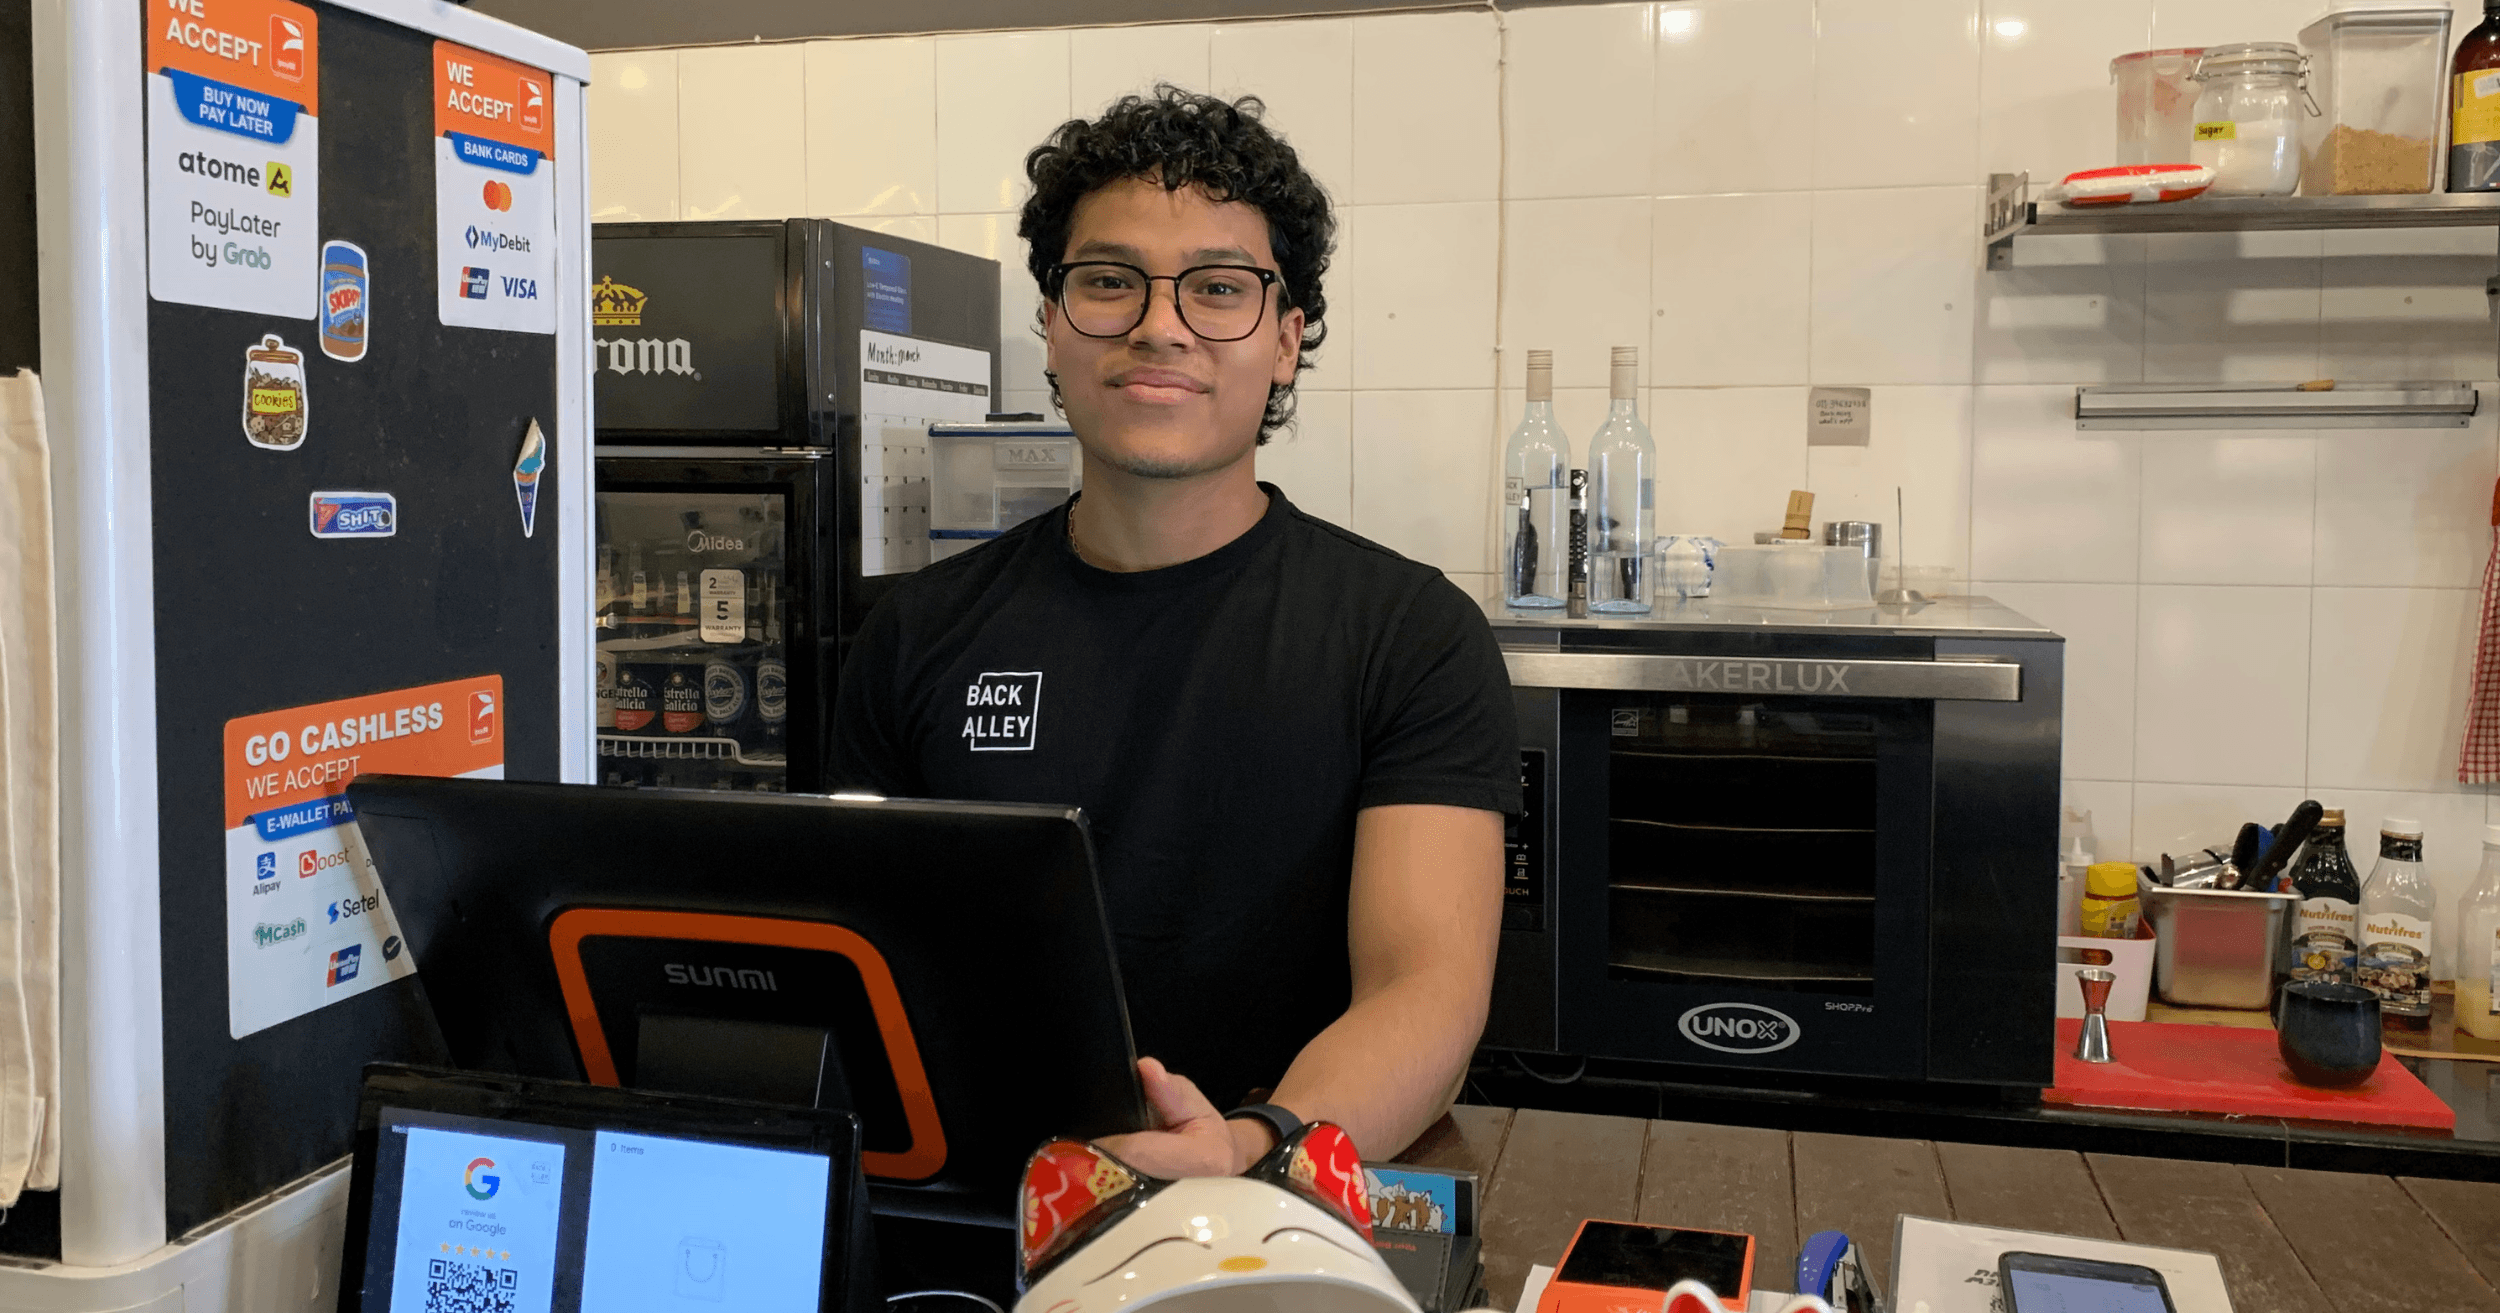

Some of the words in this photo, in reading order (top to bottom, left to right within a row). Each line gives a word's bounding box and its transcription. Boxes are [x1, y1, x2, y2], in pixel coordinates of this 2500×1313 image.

[166, 17, 262, 66] ACCEPT
[446, 60, 474, 87] WE
[203, 86, 232, 108] BUY
[236, 95, 270, 117] NOW
[447, 88, 513, 123] ACCEPT
[200, 103, 227, 124] PAY
[229, 113, 273, 136] LATER
[464, 141, 492, 159] BANK
[495, 149, 528, 167] CARDS
[179, 151, 260, 187] atome
[191, 200, 281, 238] PayLater
[191, 234, 217, 268] by
[223, 241, 271, 270] Grab
[480, 230, 531, 253] MyDebit
[500, 275, 537, 300] VISA
[593, 338, 695, 376] rona
[1008, 449, 1056, 463] MAX
[698, 536, 744, 551] Midea
[709, 577, 717, 589] 2
[717, 601, 729, 620] 5
[704, 624, 742, 632] WARRANTY
[1672, 661, 1850, 693] AKERLUX
[615, 686, 648, 698] strella
[615, 698, 646, 710] alicia
[966, 684, 1023, 706] BACK
[245, 731, 290, 766] GO
[300, 702, 443, 755] CASHLESS
[962, 715, 1030, 738] ALLEY
[246, 772, 279, 800] WE
[284, 756, 360, 793] ACCEPT
[267, 804, 330, 833] E-WALLET
[253, 880, 281, 896] Alipay
[1503, 887, 1529, 896] OUCH
[343, 889, 379, 919] Setel
[2299, 908, 2354, 922] Nutrifres
[2366, 923, 2422, 939] Nutrifres
[664, 963, 778, 991] SUNMI
[1693, 1015, 1778, 1041] UNOX
[448, 1219, 464, 1229] on
[465, 1219, 507, 1237] Google
